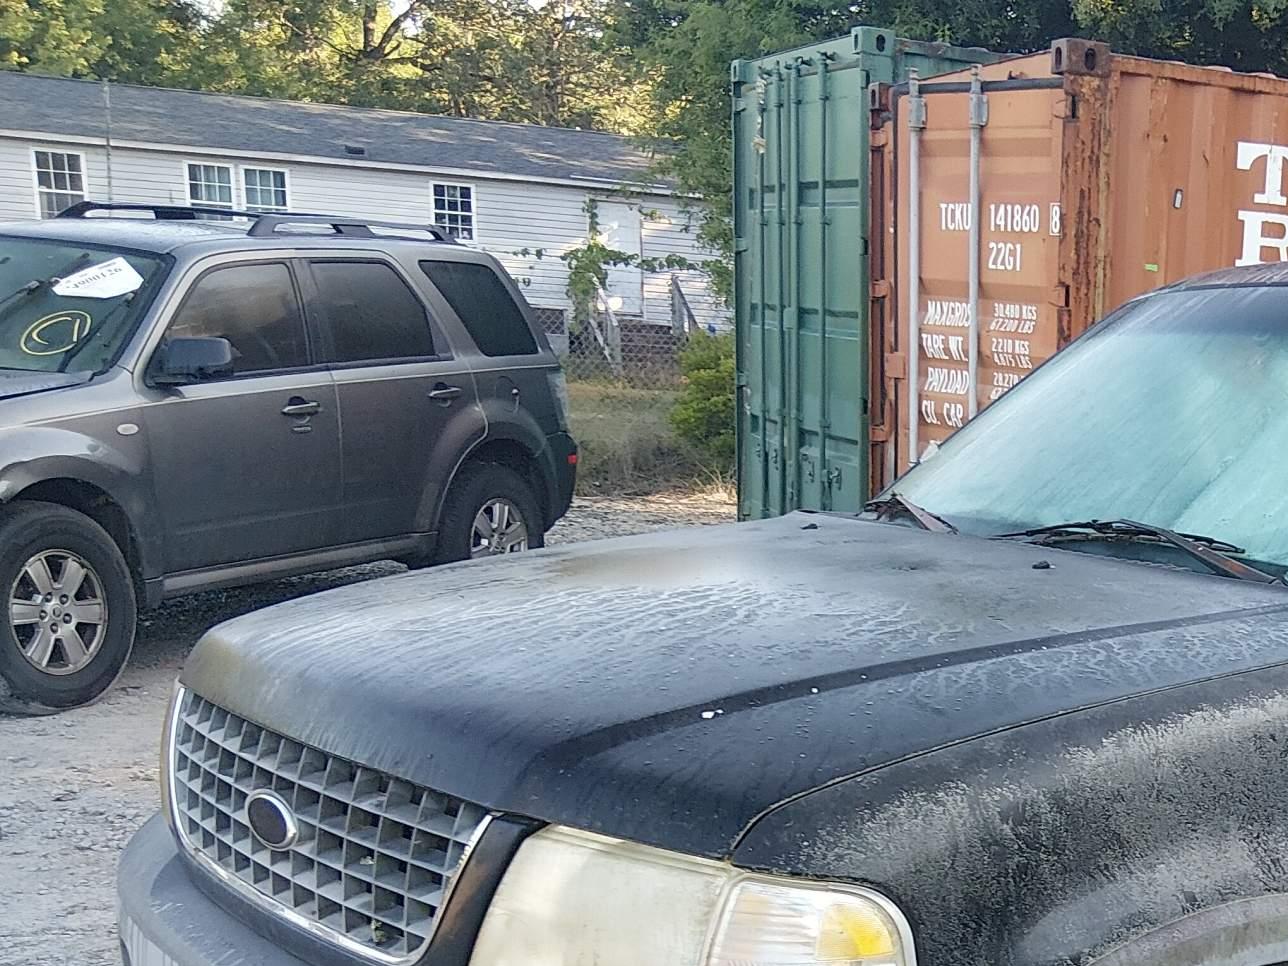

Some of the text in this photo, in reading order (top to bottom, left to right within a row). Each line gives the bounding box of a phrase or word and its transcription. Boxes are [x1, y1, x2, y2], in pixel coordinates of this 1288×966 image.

[939, 203, 1061, 234] TCKU 141860 8
[988, 242, 1021, 272] 22G1
[921, 333, 950, 360] TARE
[924, 367, 970, 395] PAYLOAD
